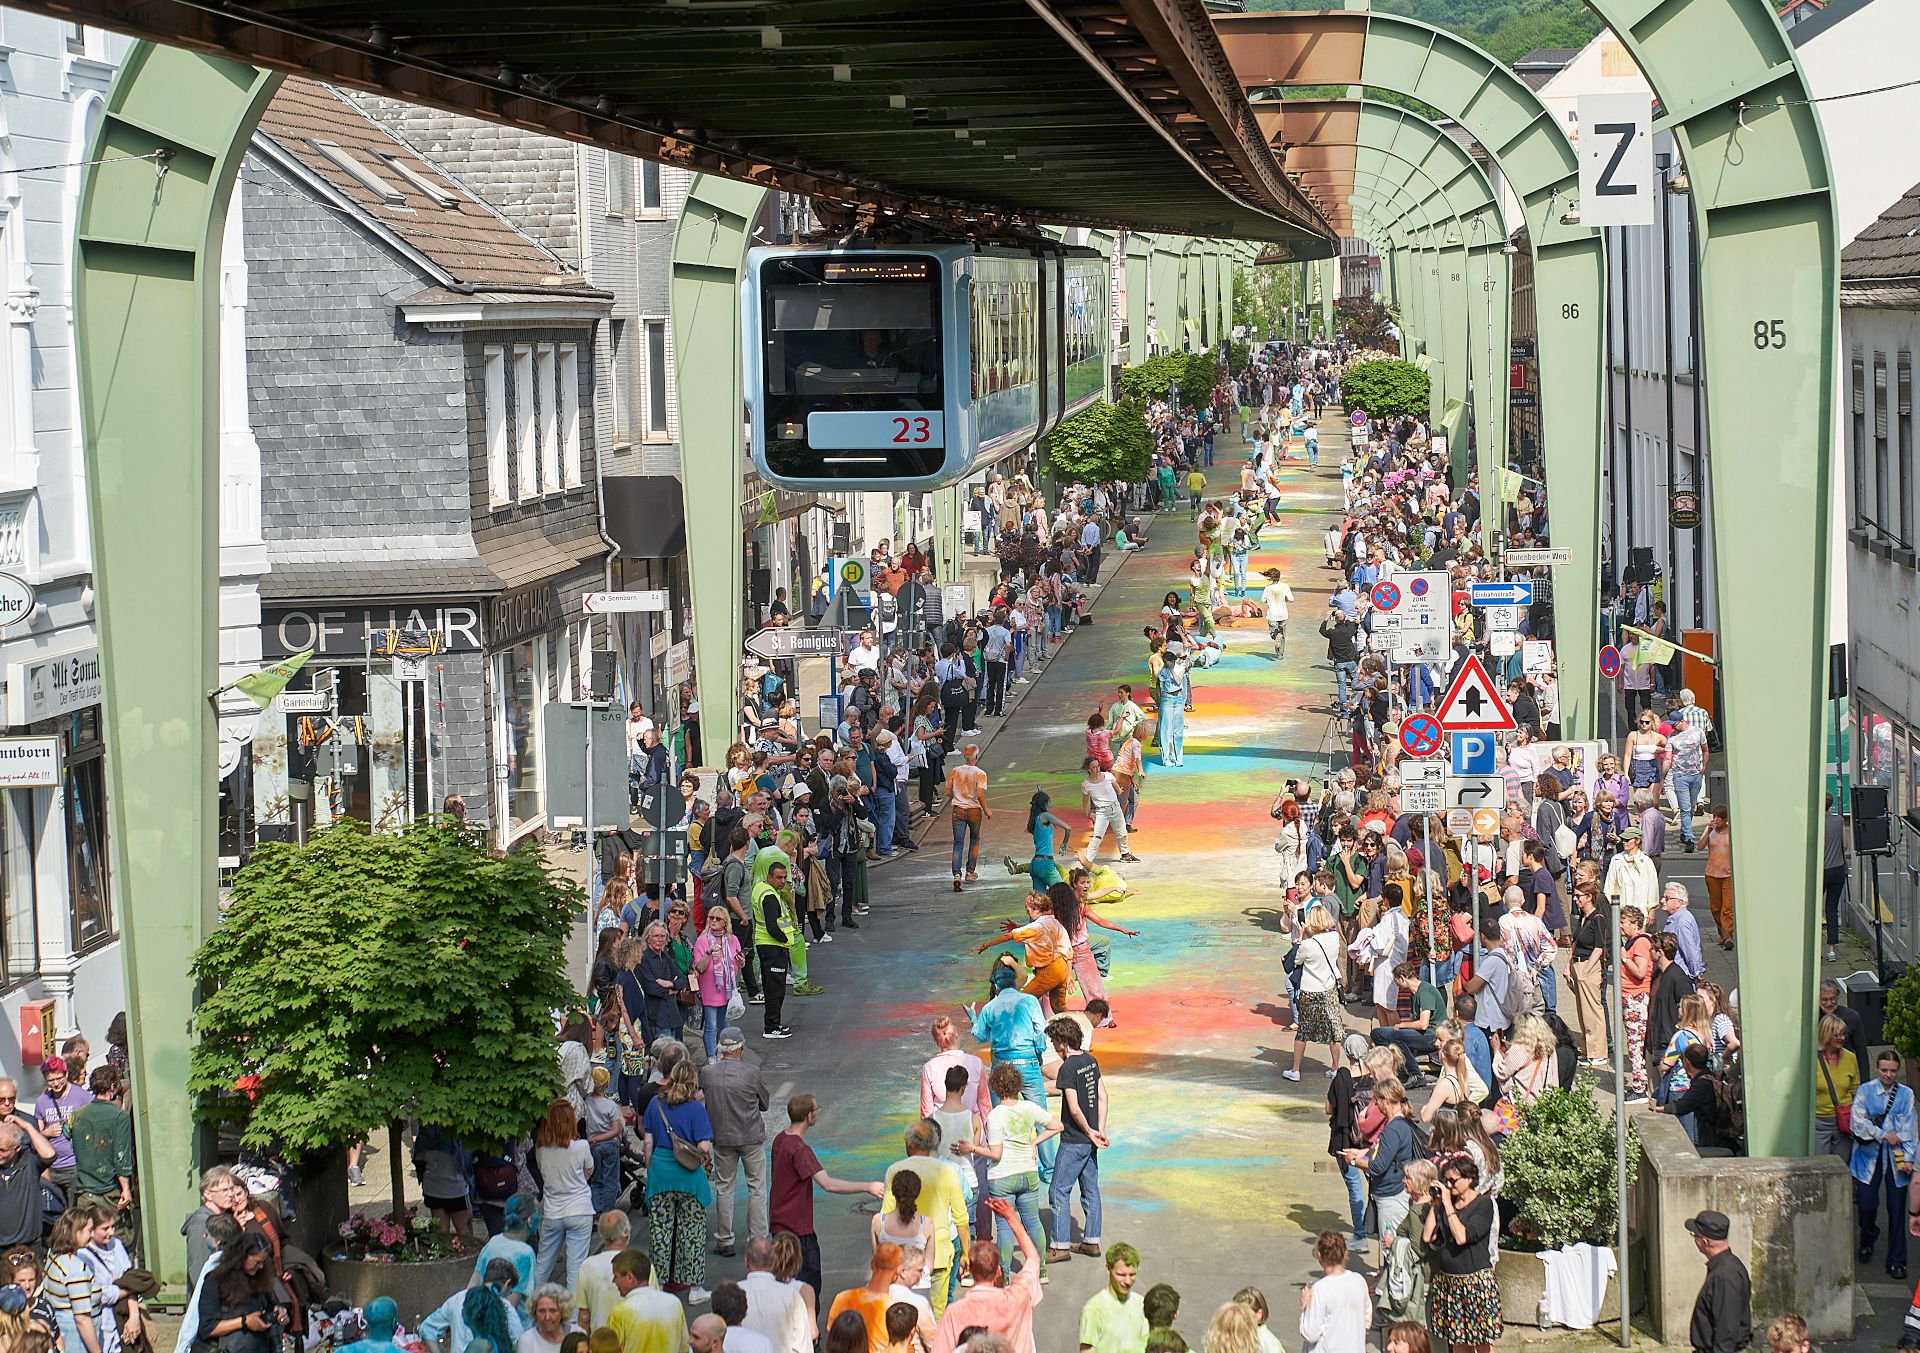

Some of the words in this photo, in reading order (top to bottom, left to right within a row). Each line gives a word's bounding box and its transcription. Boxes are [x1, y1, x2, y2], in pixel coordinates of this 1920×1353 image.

[1594, 122, 1637, 196] Z
[1451, 273, 1460, 281] 88
[1483, 281, 1496, 292] 87
[1562, 303, 1579, 319] 86
[1754, 319, 1787, 350] 85
[892, 417, 930, 443] 23
[1552, 552, 1567, 560] Weg
[278, 611, 346, 652] OF
[364, 607, 481, 648] HAIR
[494, 598, 512, 642] ART
[515, 593, 527, 633] OF
[771, 635, 786, 650] St.
[790, 634, 837, 650] Remigius
[52, 660, 67, 690] Alt
[68, 687, 79, 702] Treff
[1462, 737, 1485, 770] P
